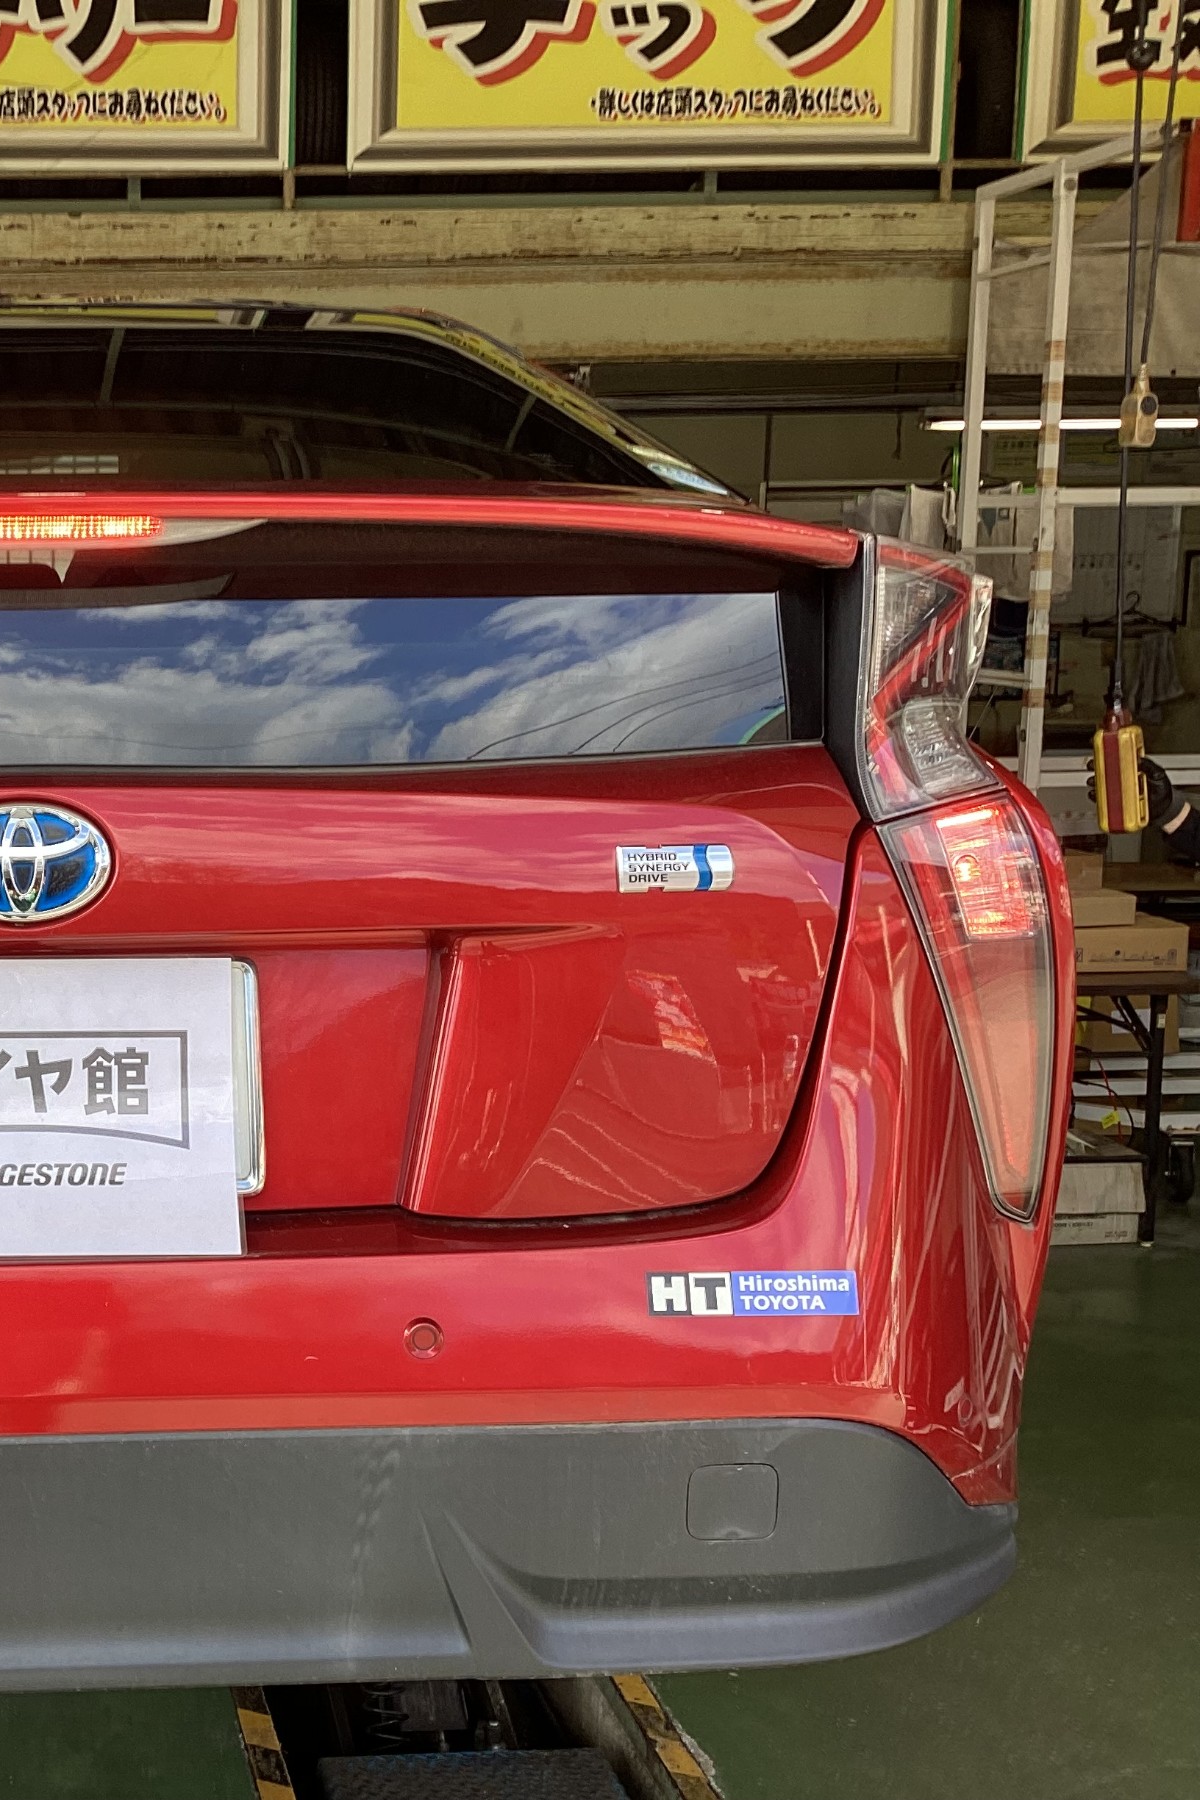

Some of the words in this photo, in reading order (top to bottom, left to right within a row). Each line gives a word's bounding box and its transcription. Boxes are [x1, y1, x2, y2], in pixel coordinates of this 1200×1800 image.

[627, 852, 677, 861] HYBRID
[628, 862, 691, 872] SYNERGY
[628, 873, 669, 883] DRIVE
[738, 1275, 850, 1292] Hiroshima
[739, 1295, 826, 1311] TOYOTA
